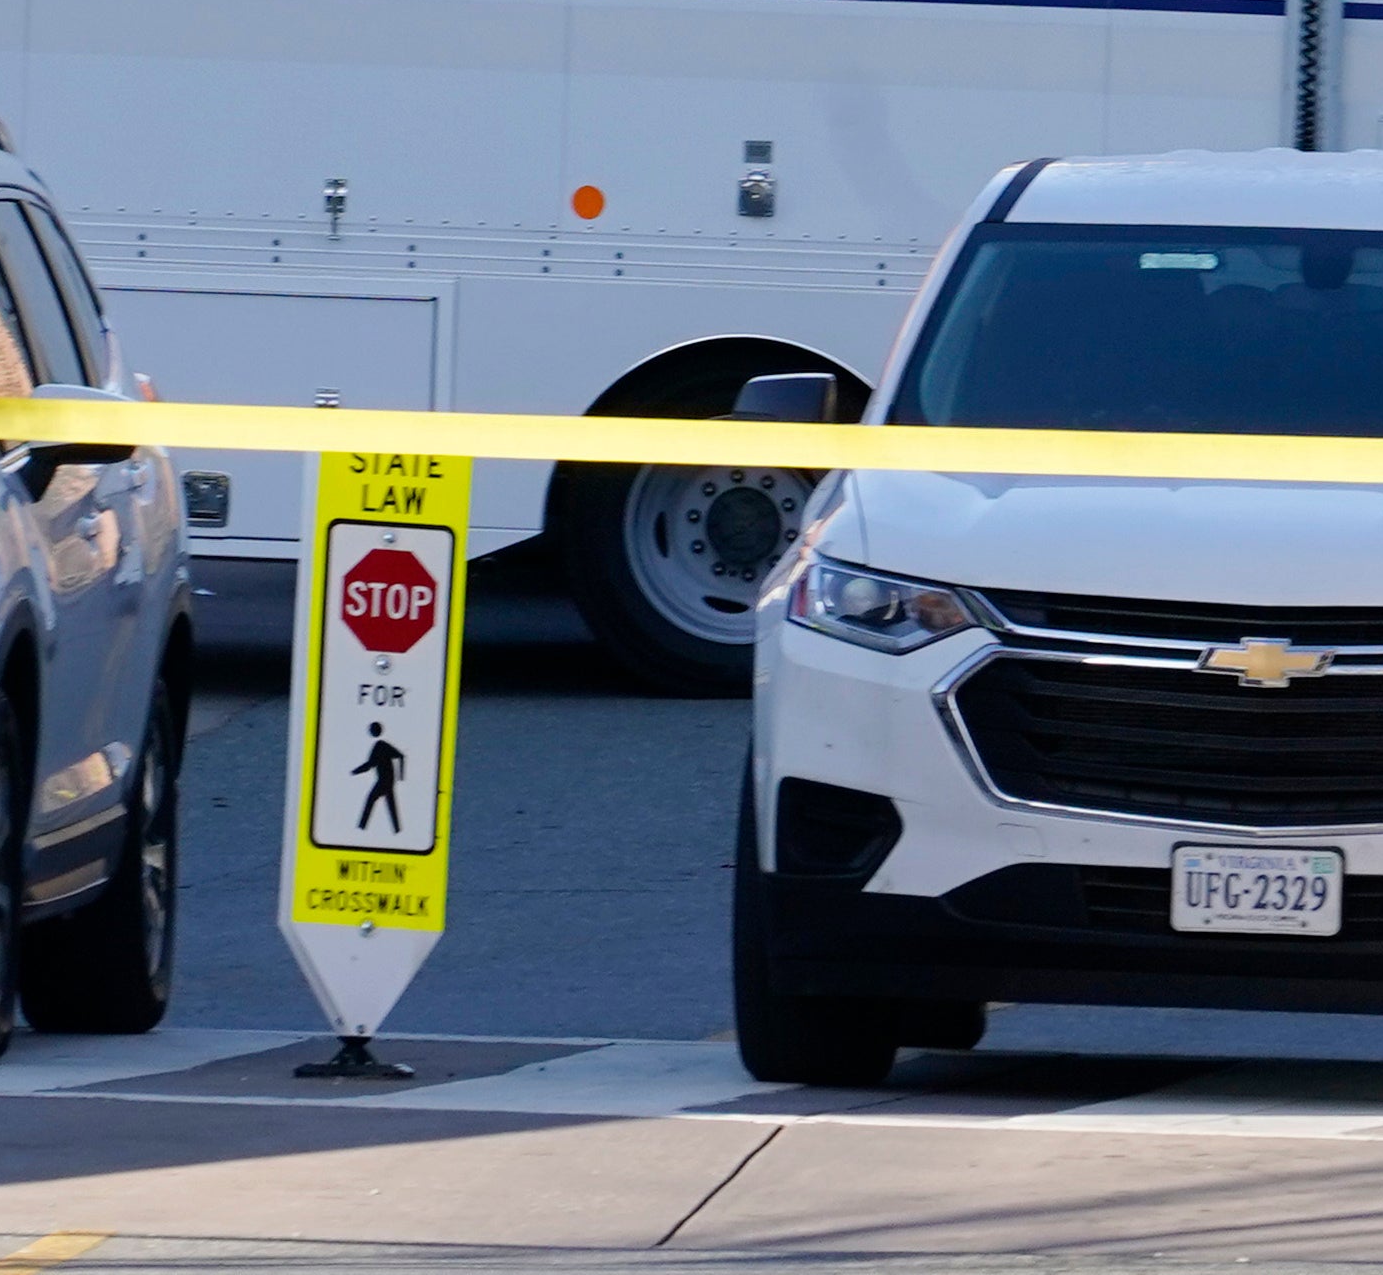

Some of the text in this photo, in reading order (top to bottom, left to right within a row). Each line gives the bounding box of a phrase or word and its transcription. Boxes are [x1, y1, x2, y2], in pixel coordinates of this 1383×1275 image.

[361, 484, 426, 515] LAW
[345, 580, 433, 620] STOP
[358, 684, 406, 707] FOR
[336, 859, 406, 884] WITHIN
[305, 888, 430, 917] CROSSWALK
[1184, 871, 1329, 912] UFG-2329
